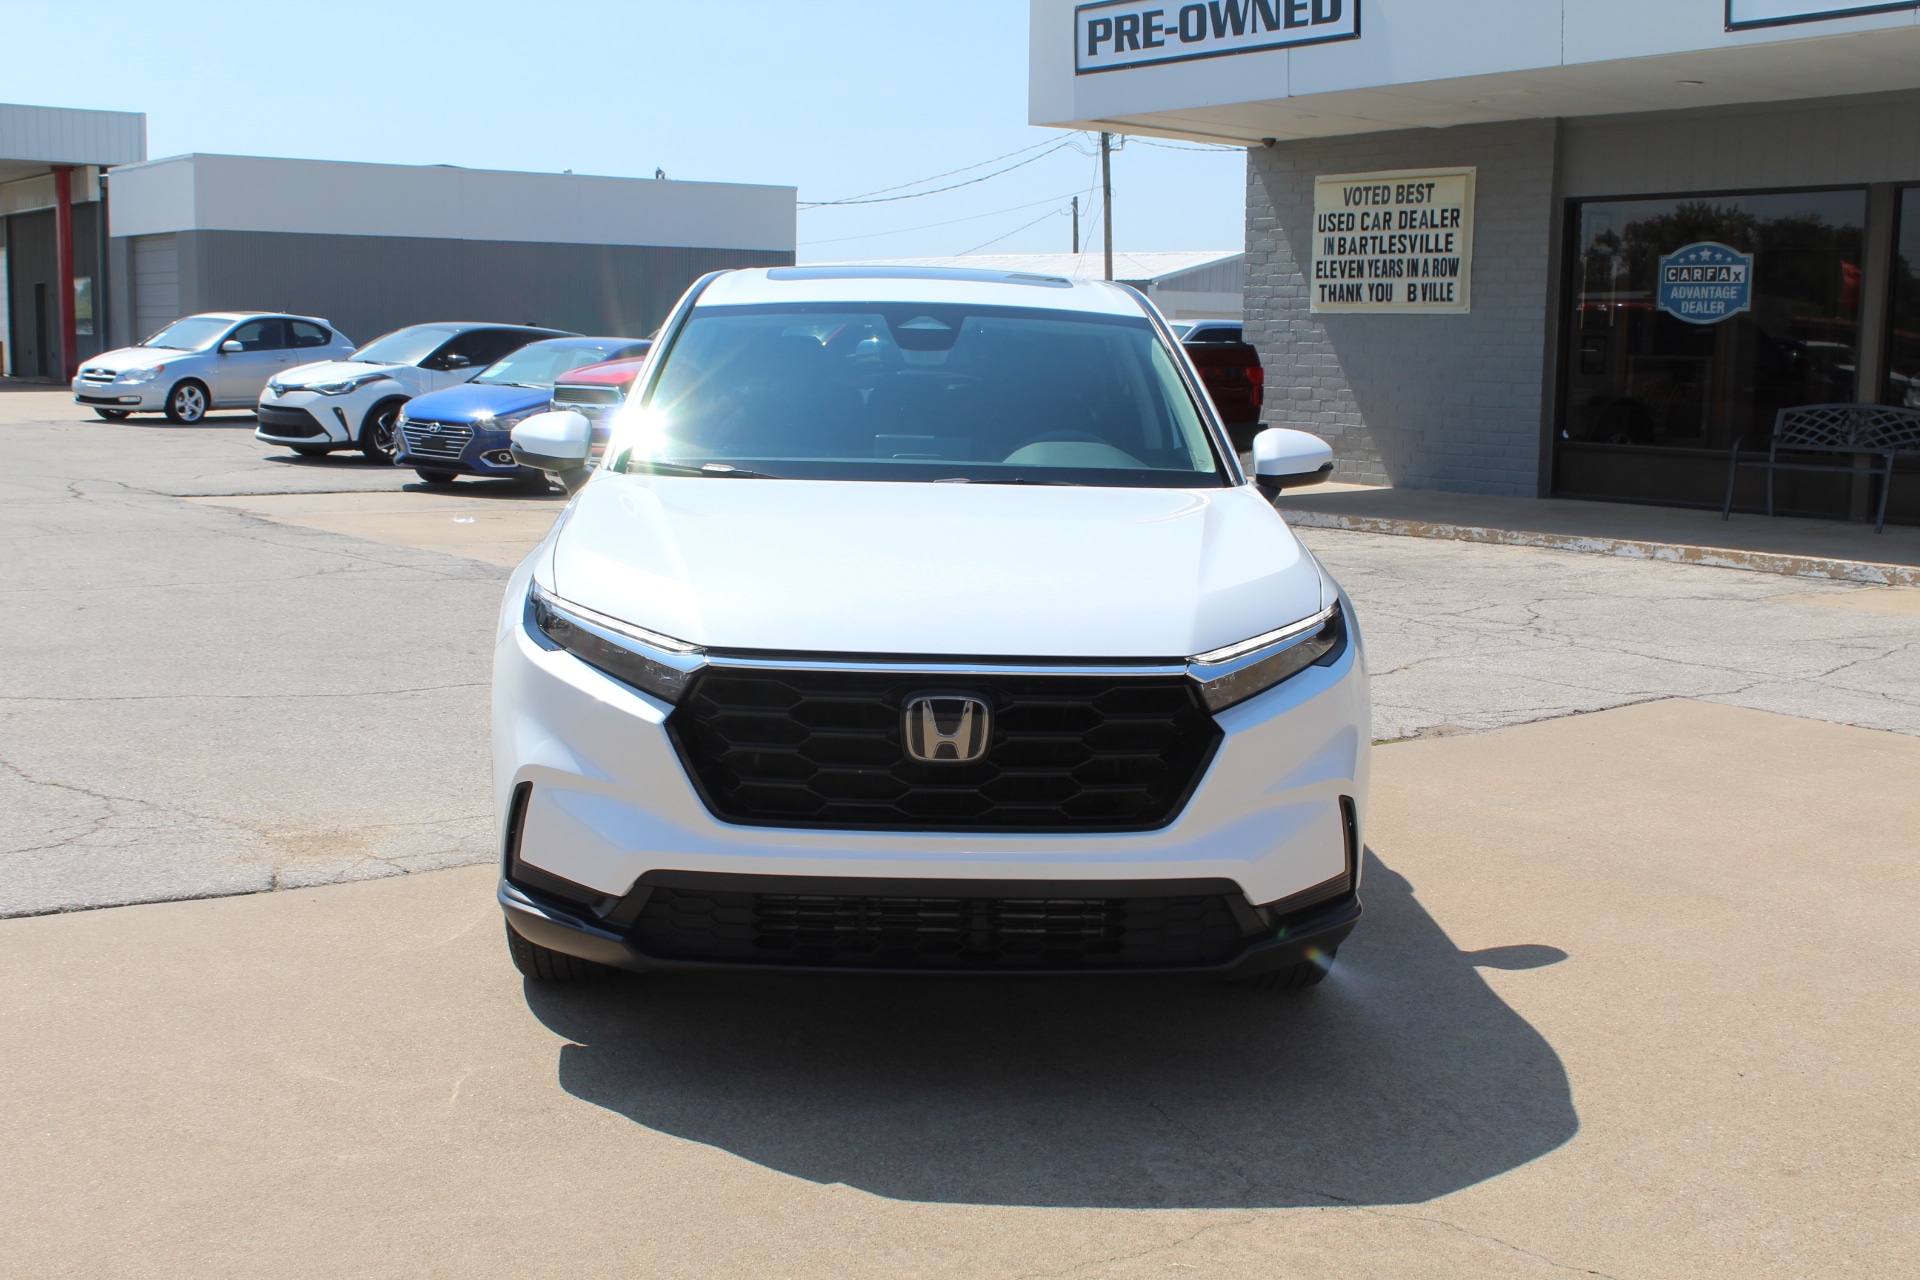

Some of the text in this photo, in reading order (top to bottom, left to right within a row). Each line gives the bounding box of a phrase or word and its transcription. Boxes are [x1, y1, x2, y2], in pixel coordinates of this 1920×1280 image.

[1087, 0, 1342, 56] PRE-OWNED
[1343, 183, 1435, 206] VOTED BEST
[1318, 208, 1460, 233] USED CAR DEALER
[1323, 233, 1454, 256] IN BARTLESVILLE
[1316, 257, 1460, 279] ELEVEN YEARS IN A ROW
[1319, 283, 1363, 302] THANK
[1368, 283, 1393, 302] YOU
[1670, 286, 1738, 299] ADVANTAGE
[1681, 301, 1725, 314] DEALER
